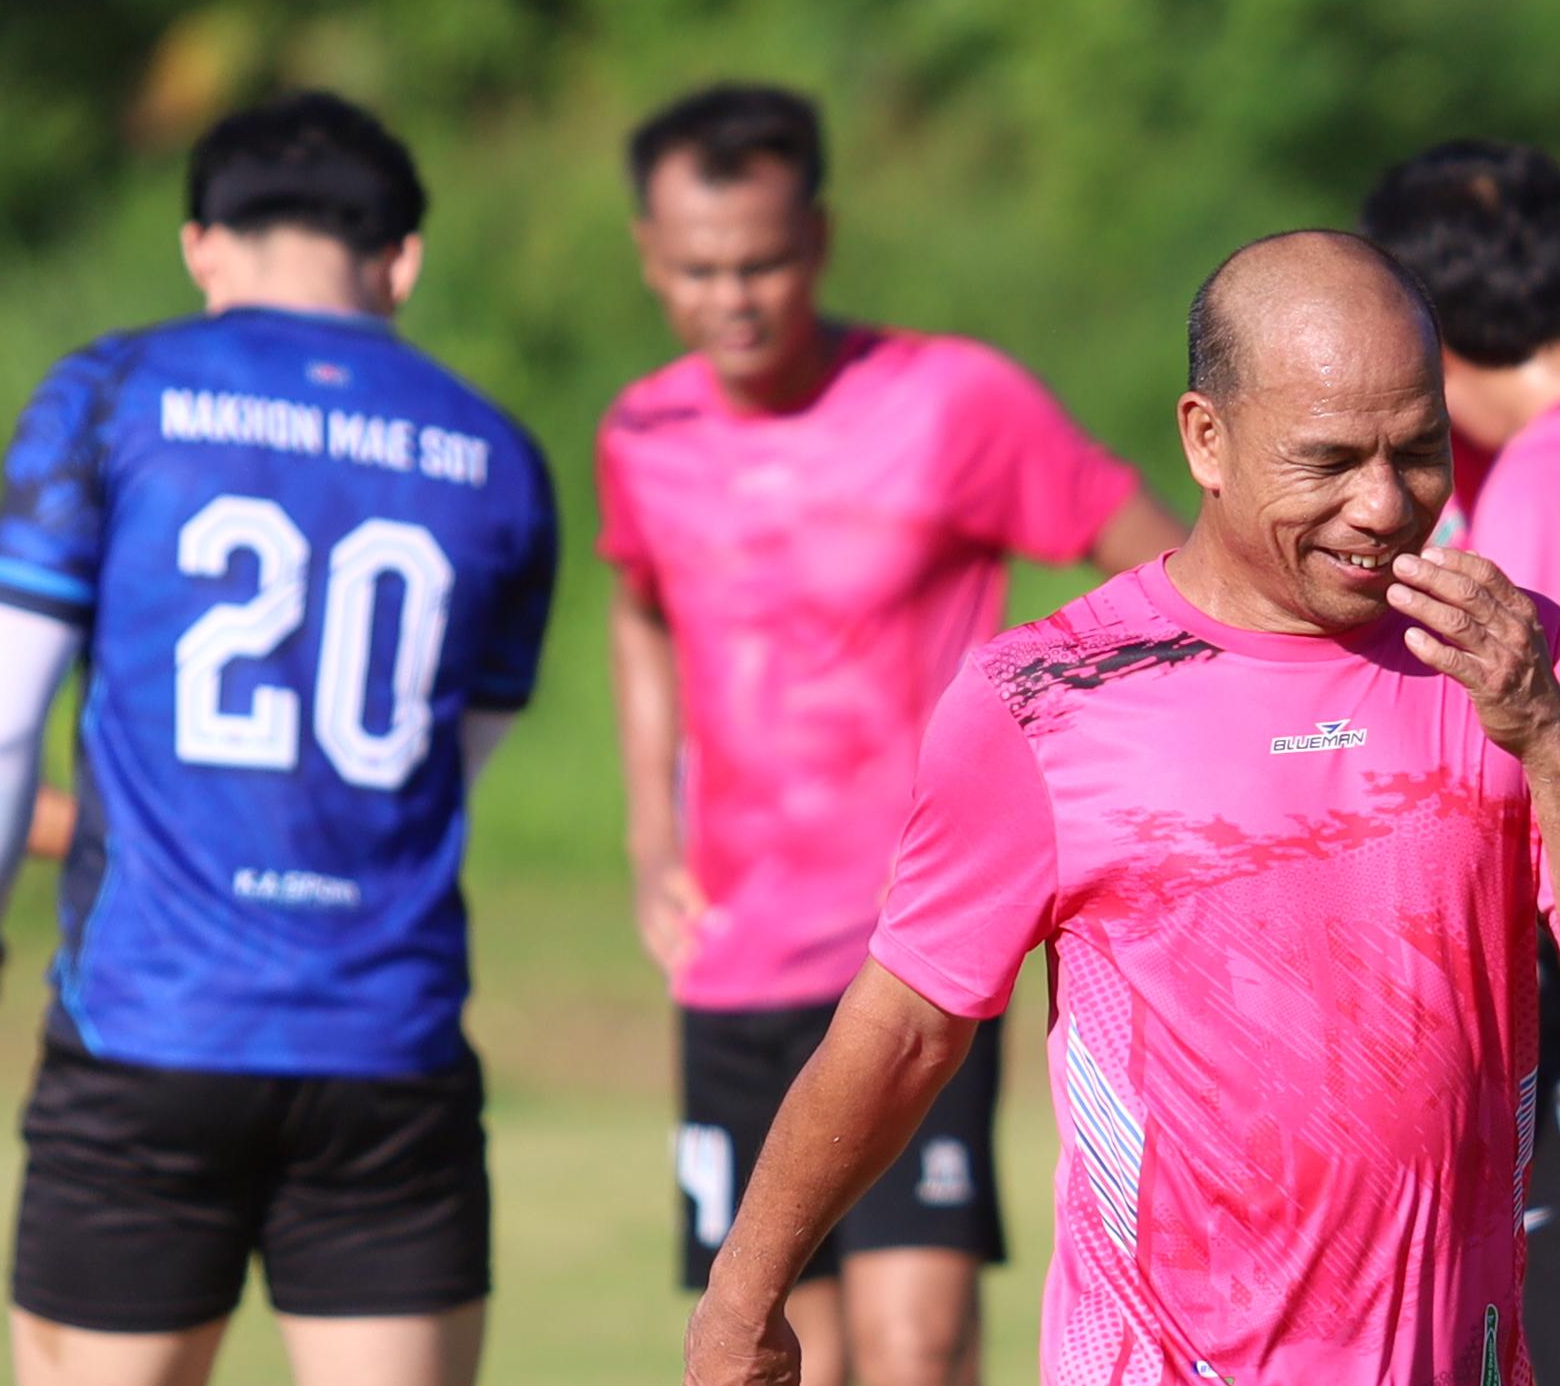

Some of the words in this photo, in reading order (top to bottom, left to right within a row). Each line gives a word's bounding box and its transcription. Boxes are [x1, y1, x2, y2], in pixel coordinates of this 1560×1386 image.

[161, 387, 324, 458] NAKHON
[328, 408, 416, 473] MAE
[418, 425, 490, 490] SOT
[175, 493, 455, 791] 20
[1271, 730, 1366, 752] BLUEMAN
